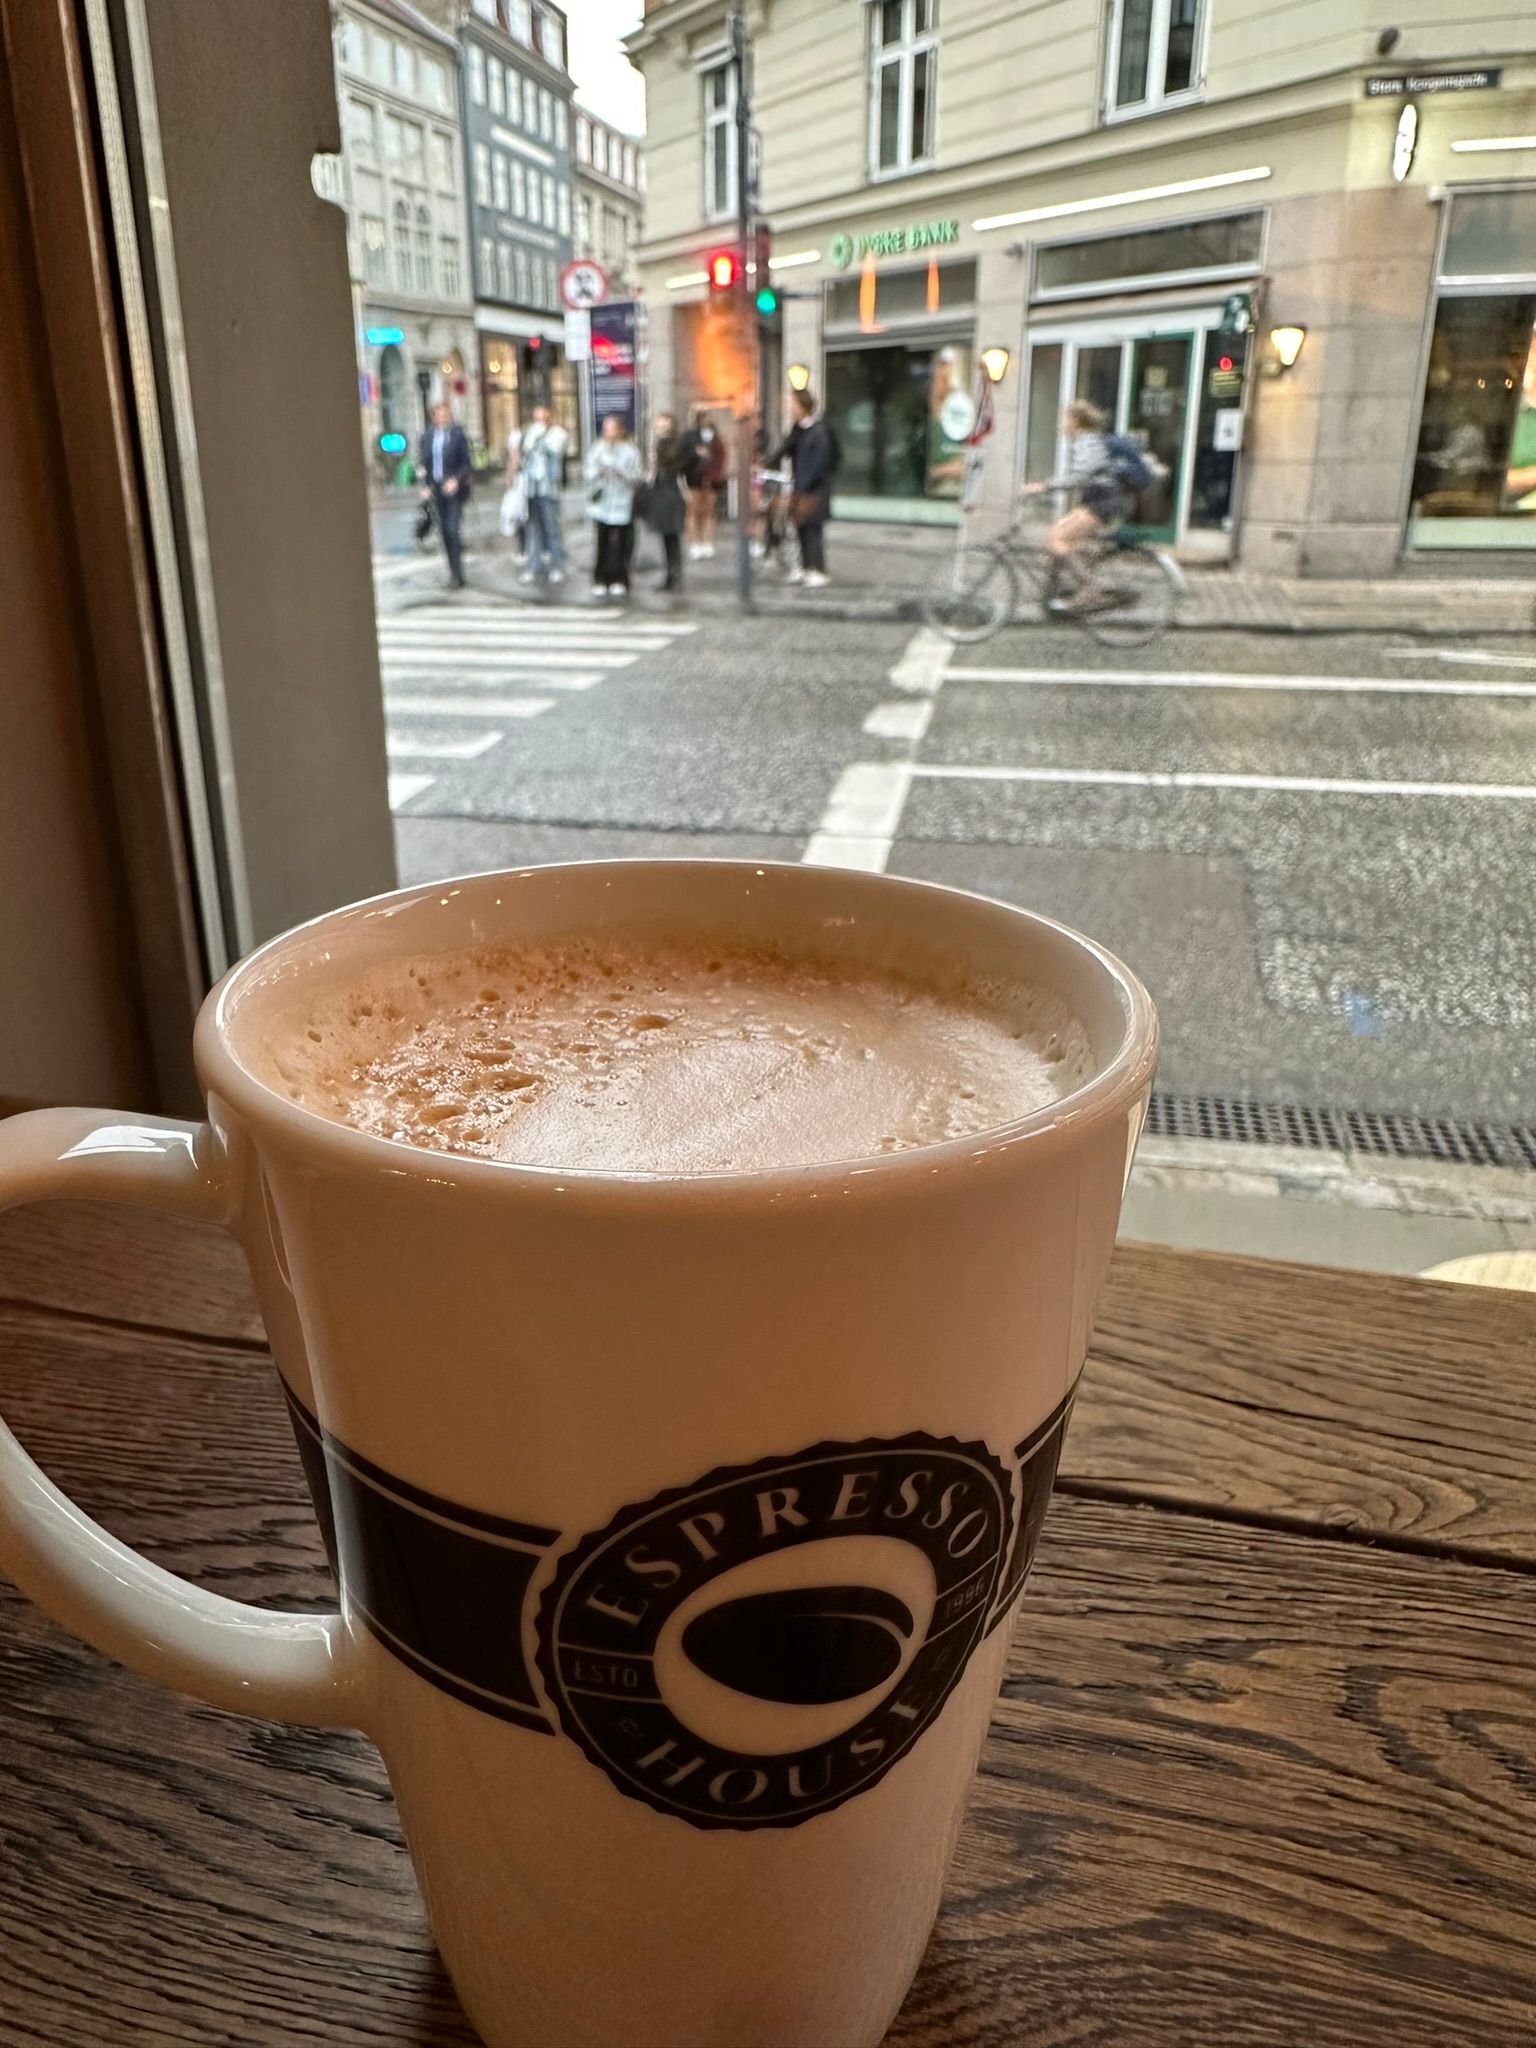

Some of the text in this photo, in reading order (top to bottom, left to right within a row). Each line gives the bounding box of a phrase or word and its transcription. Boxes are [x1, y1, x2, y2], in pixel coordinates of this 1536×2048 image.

[585, 1470, 989, 1629] ESPRESSO
[574, 1657, 639, 1688] ESTD
[634, 1680, 934, 1803] HOUSE
